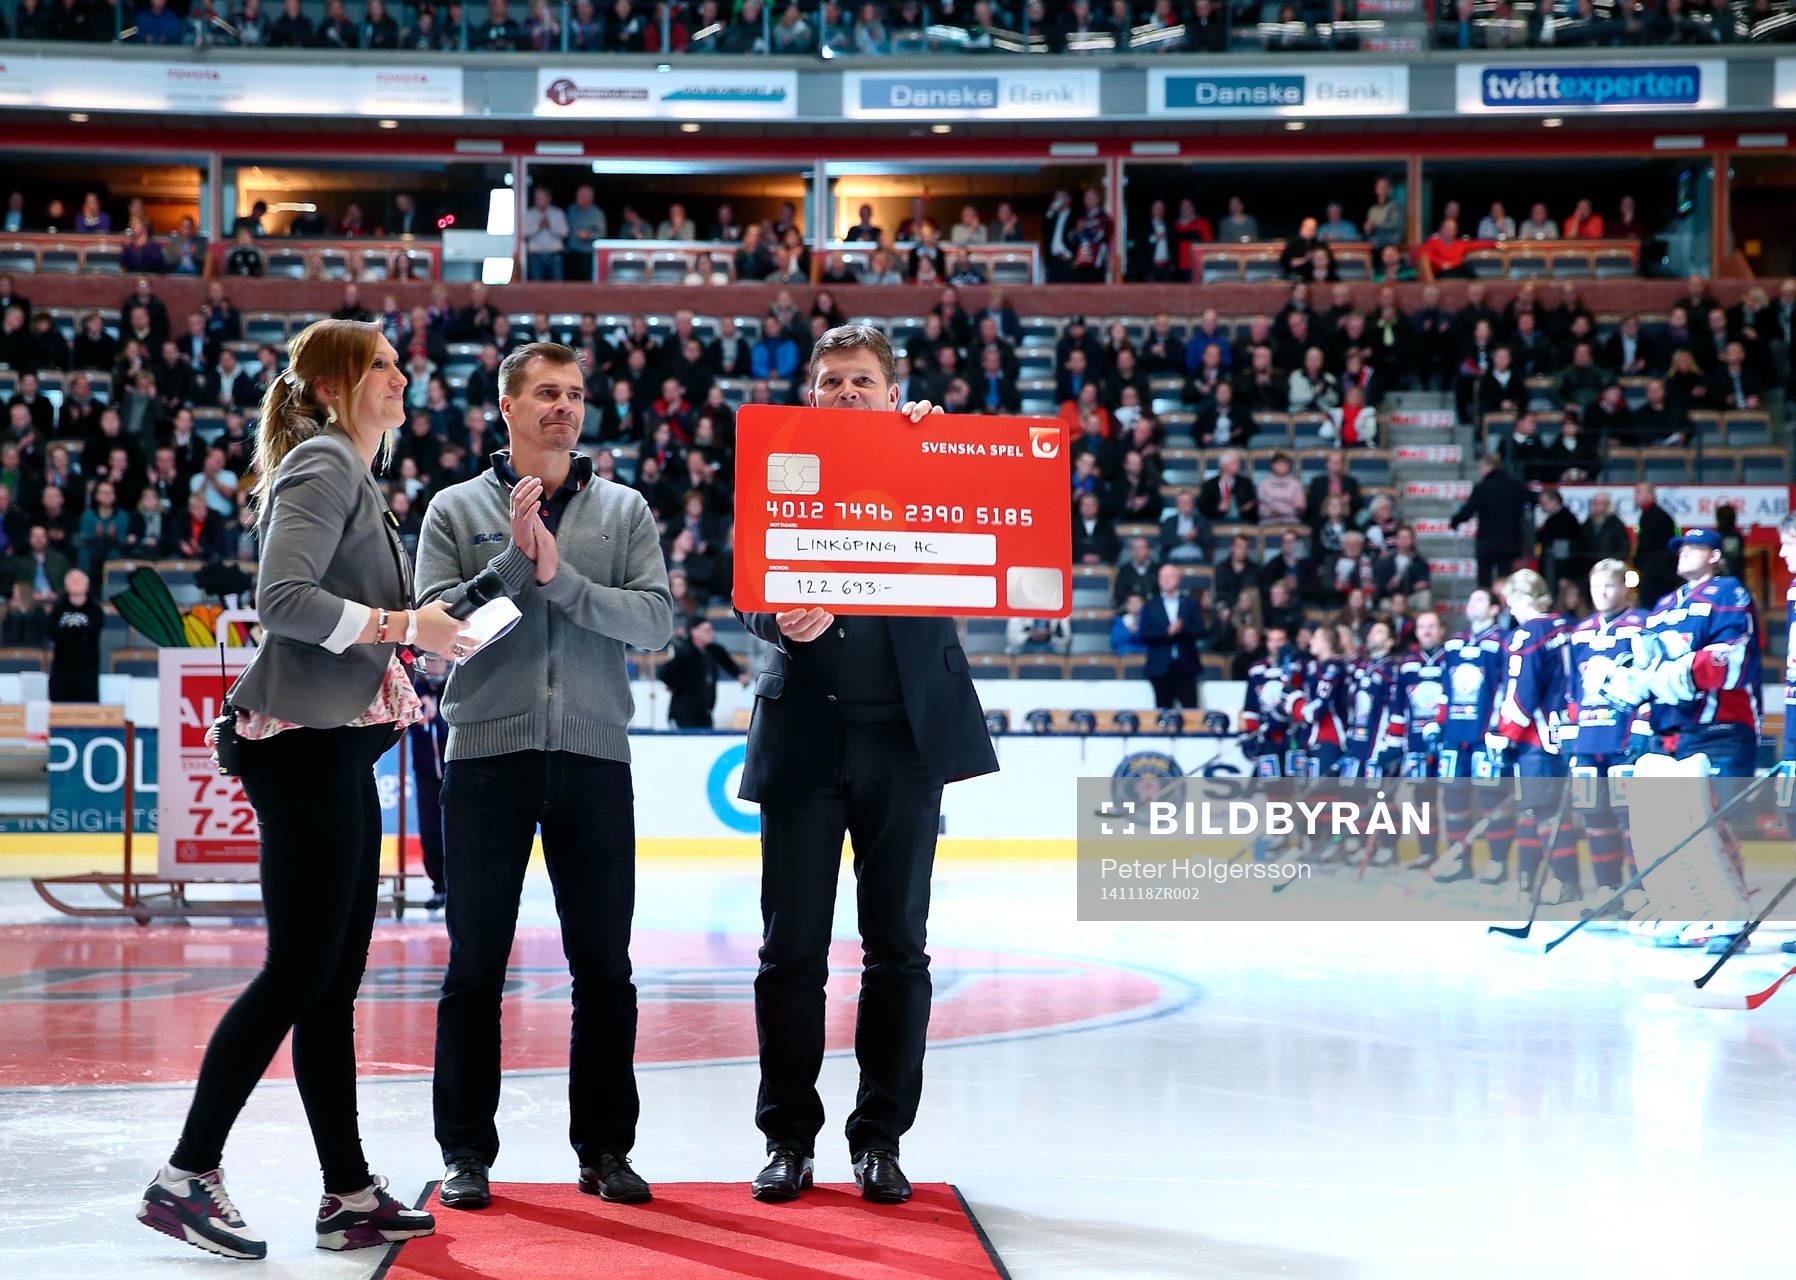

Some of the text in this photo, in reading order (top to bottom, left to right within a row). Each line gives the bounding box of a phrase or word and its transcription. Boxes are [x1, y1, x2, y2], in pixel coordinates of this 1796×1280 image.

[891, 84, 1075, 106] Danske Bank
[1196, 82, 1384, 104] Danske Bank
[1487, 71, 1695, 103] tvättexperten
[921, 442, 1024, 457] SVENSKA SPEL
[766, 500, 1032, 526] 4012 7496 2390 5185
[914, 541, 938, 554] HC
[797, 579, 832, 594] 122
